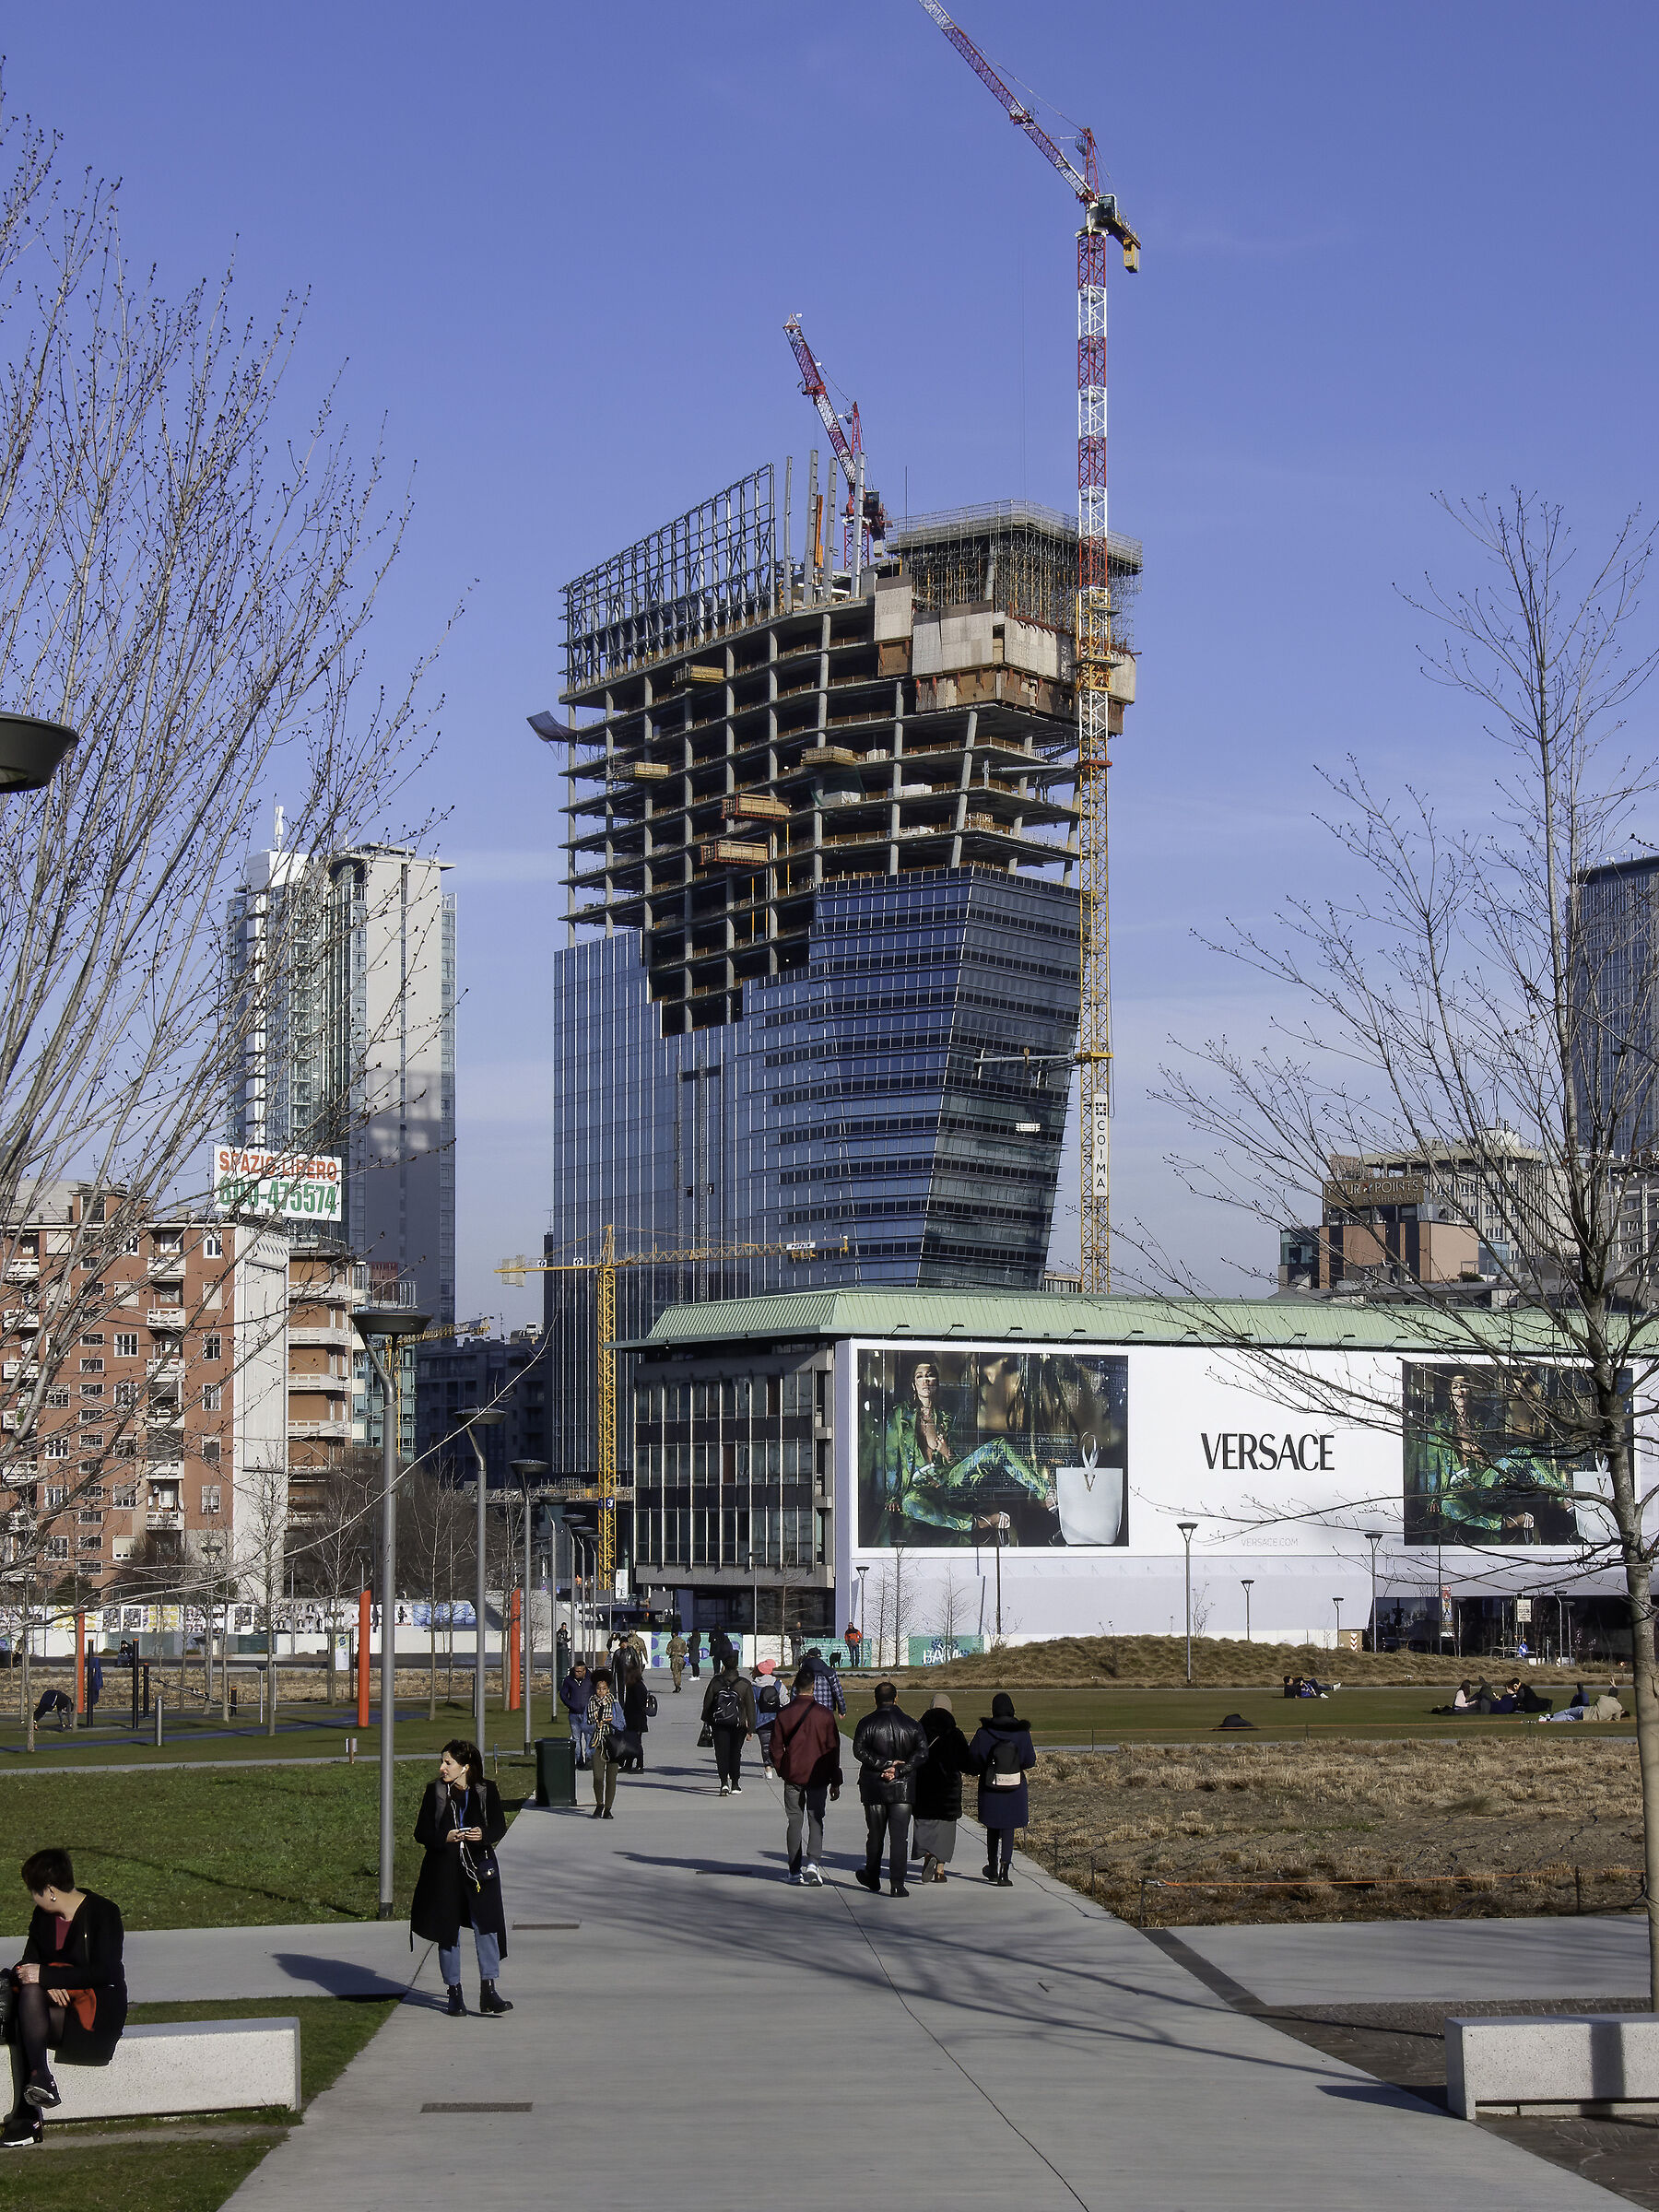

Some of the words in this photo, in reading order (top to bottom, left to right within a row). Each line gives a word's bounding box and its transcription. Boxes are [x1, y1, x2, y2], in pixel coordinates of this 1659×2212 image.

[219, 1150, 276, 1176] SPAZIO
[282, 1159, 337, 1182] LIBERO
[1096, 1120, 1106, 1188] COIMA
[1375, 1180, 1419, 1194] POINTS
[1200, 1432, 1335, 1471] VERSACE
[1241, 1537, 1299, 1547] VERSACE.COM
